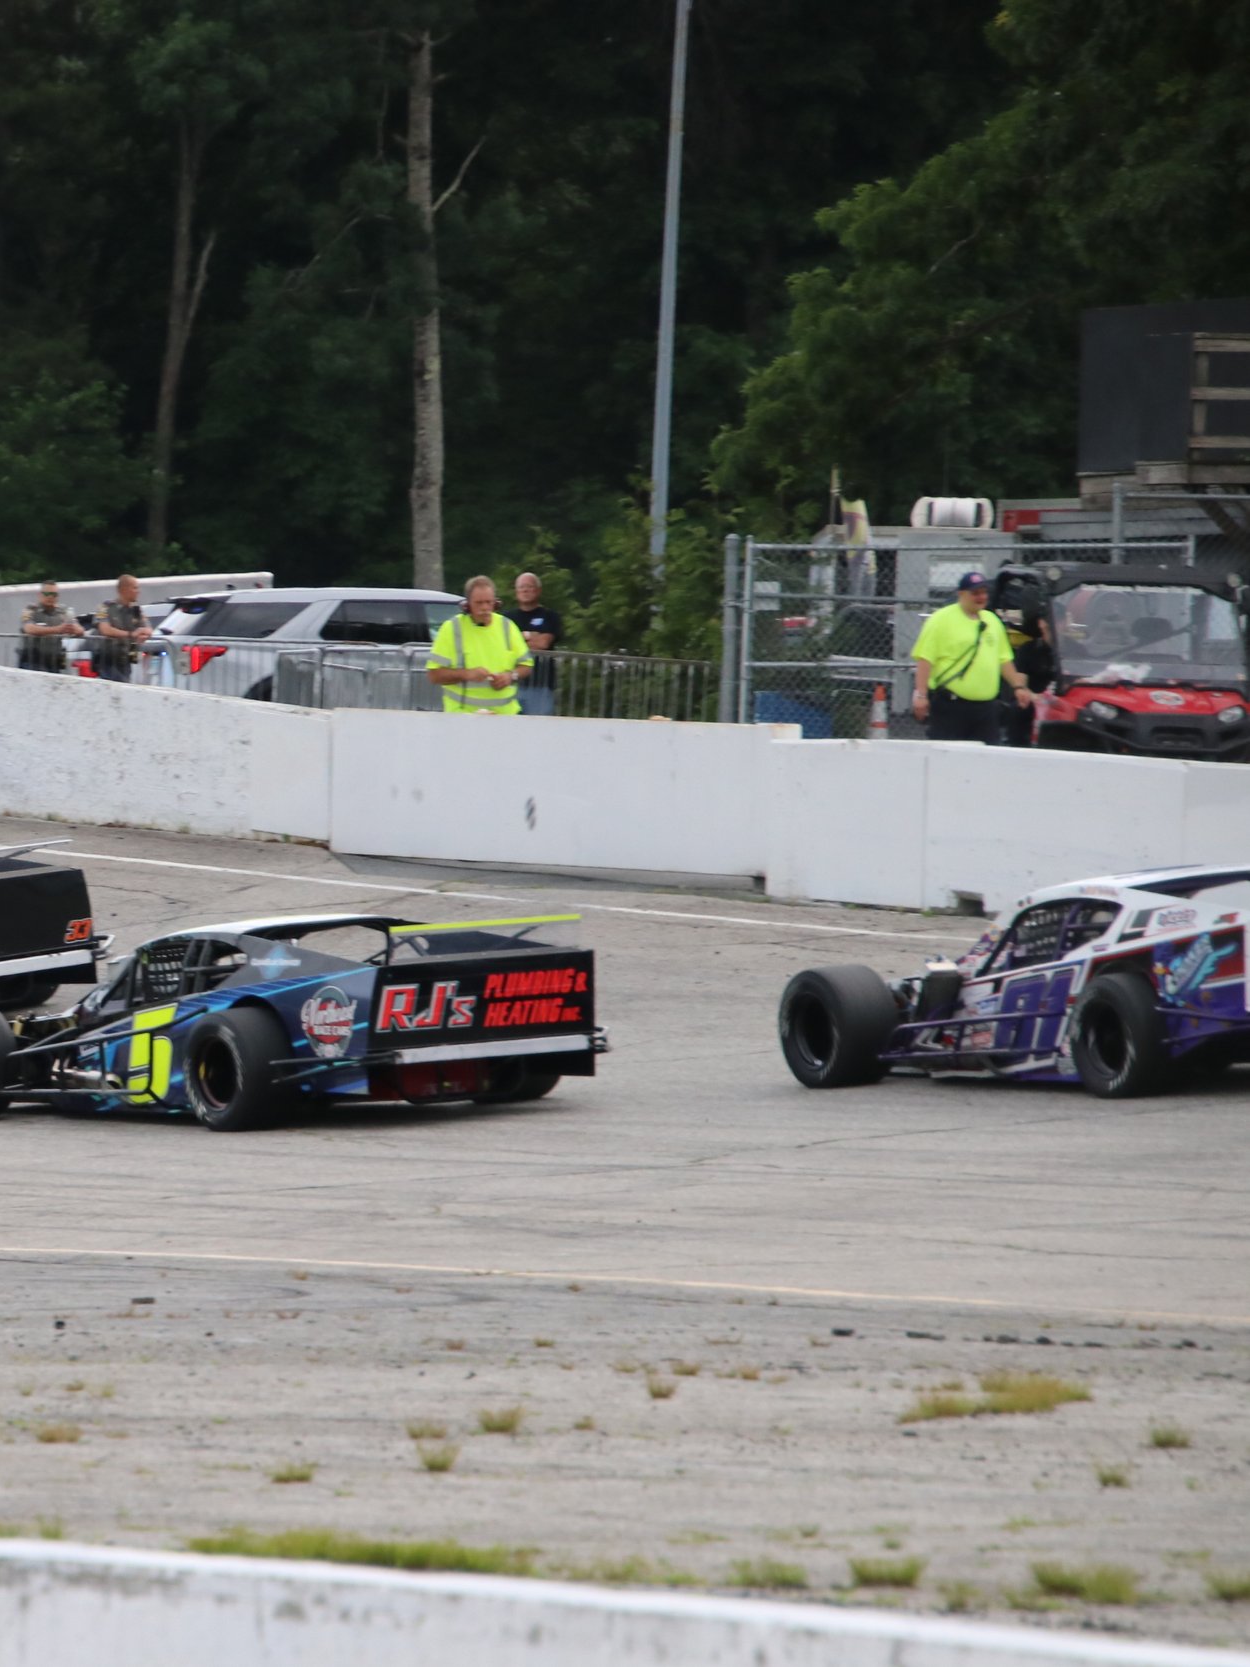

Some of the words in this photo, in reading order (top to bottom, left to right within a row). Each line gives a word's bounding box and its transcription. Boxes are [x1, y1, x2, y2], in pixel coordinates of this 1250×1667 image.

[64, 918, 93, 943] 33
[483, 968, 576, 999] PLUMBING
[375, 980, 477, 1033] RJ's
[483, 998, 564, 1028] HEATING
